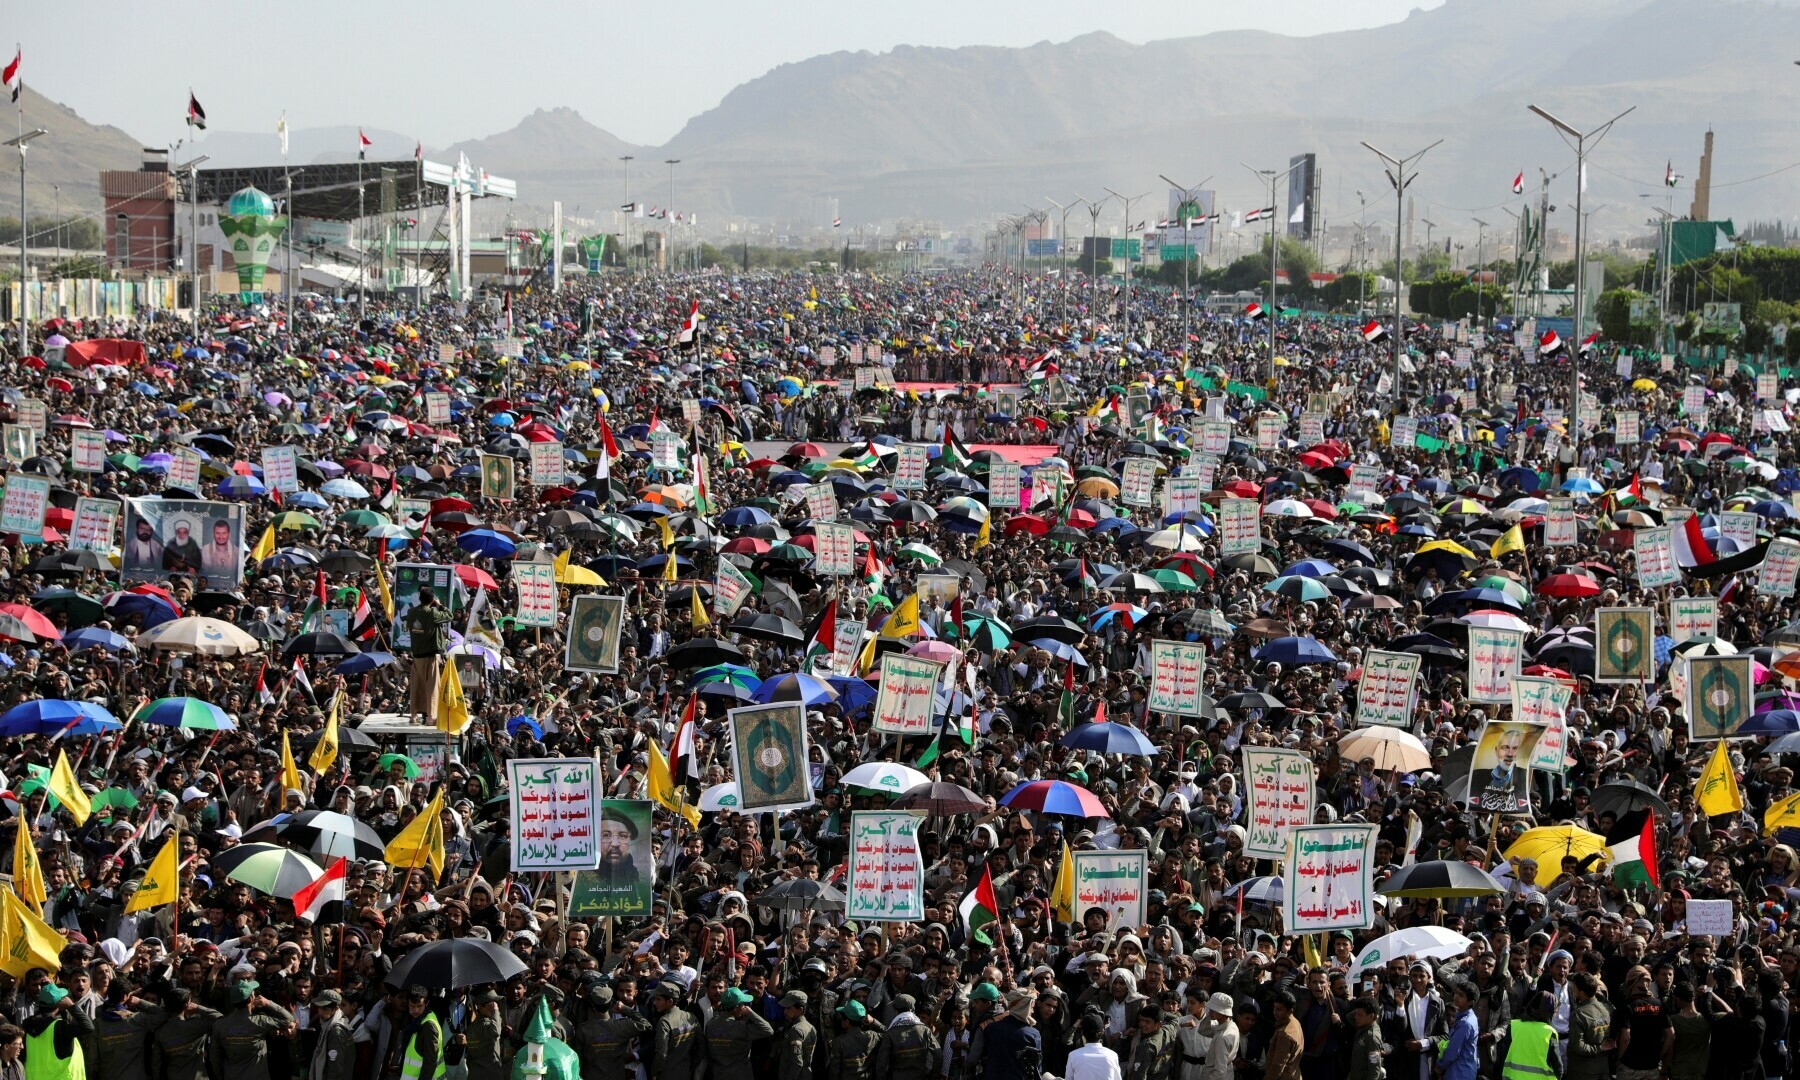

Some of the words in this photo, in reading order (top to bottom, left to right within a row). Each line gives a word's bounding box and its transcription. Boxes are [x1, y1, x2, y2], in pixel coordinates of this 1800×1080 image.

[1254, 755, 1283, 776] أكبر
[1286, 760, 1307, 775] الله
[520, 765, 561, 789] أكبر
[563, 768, 590, 784] الله
[1282, 781, 1308, 794] الموت
[560, 789, 590, 804] الموت
[1282, 798, 1308, 812] الموت
[560, 807, 590, 821] الموت
[1254, 814, 1272, 825] اليهود
[856, 816, 896, 840] أكبر
[1274, 816, 1285, 828] على
[522, 827, 547, 841] اليهود
[550, 827, 564, 841] على
[568, 826, 591, 837] اللعنة
[560, 840, 592, 862] النصر
[1299, 834, 1365, 856] قاطعوا
[891, 860, 917, 873] الموت
[1079, 862, 1139, 882] قاطعوا
[1332, 859, 1360, 878] البضائع
[855, 878, 878, 890] اليهود
[881, 879, 893, 893] على
[897, 877, 916, 890] اللعنة
[1327, 883, 1331, 896] و
[612, 896, 643, 911] فؤاد
[1110, 887, 1137, 905] البضائع
[577, 896, 608, 912] شكر
[889, 894, 916, 914] النصر
